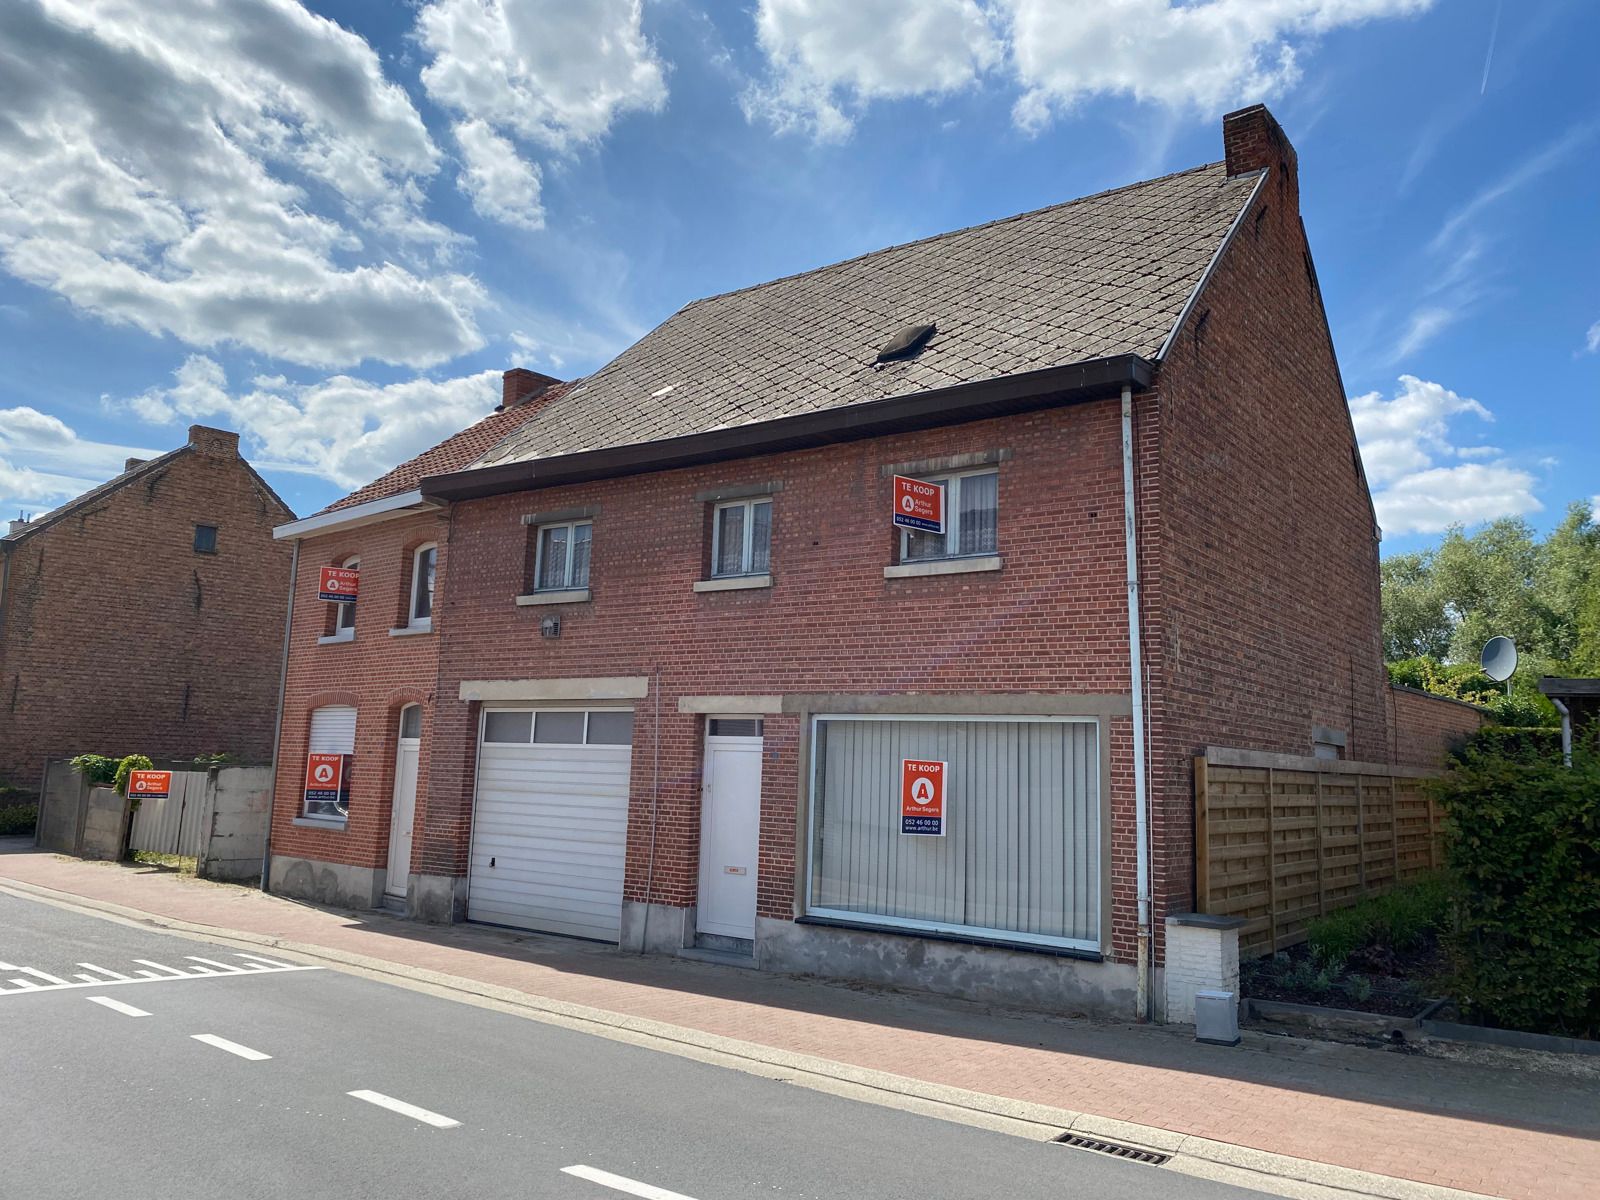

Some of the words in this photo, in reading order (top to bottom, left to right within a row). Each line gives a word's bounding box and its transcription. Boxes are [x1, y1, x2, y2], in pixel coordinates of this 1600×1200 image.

[902, 482, 911, 491] TE
[914, 484, 935, 496] KOOP
[915, 499, 931, 508] Arthur
